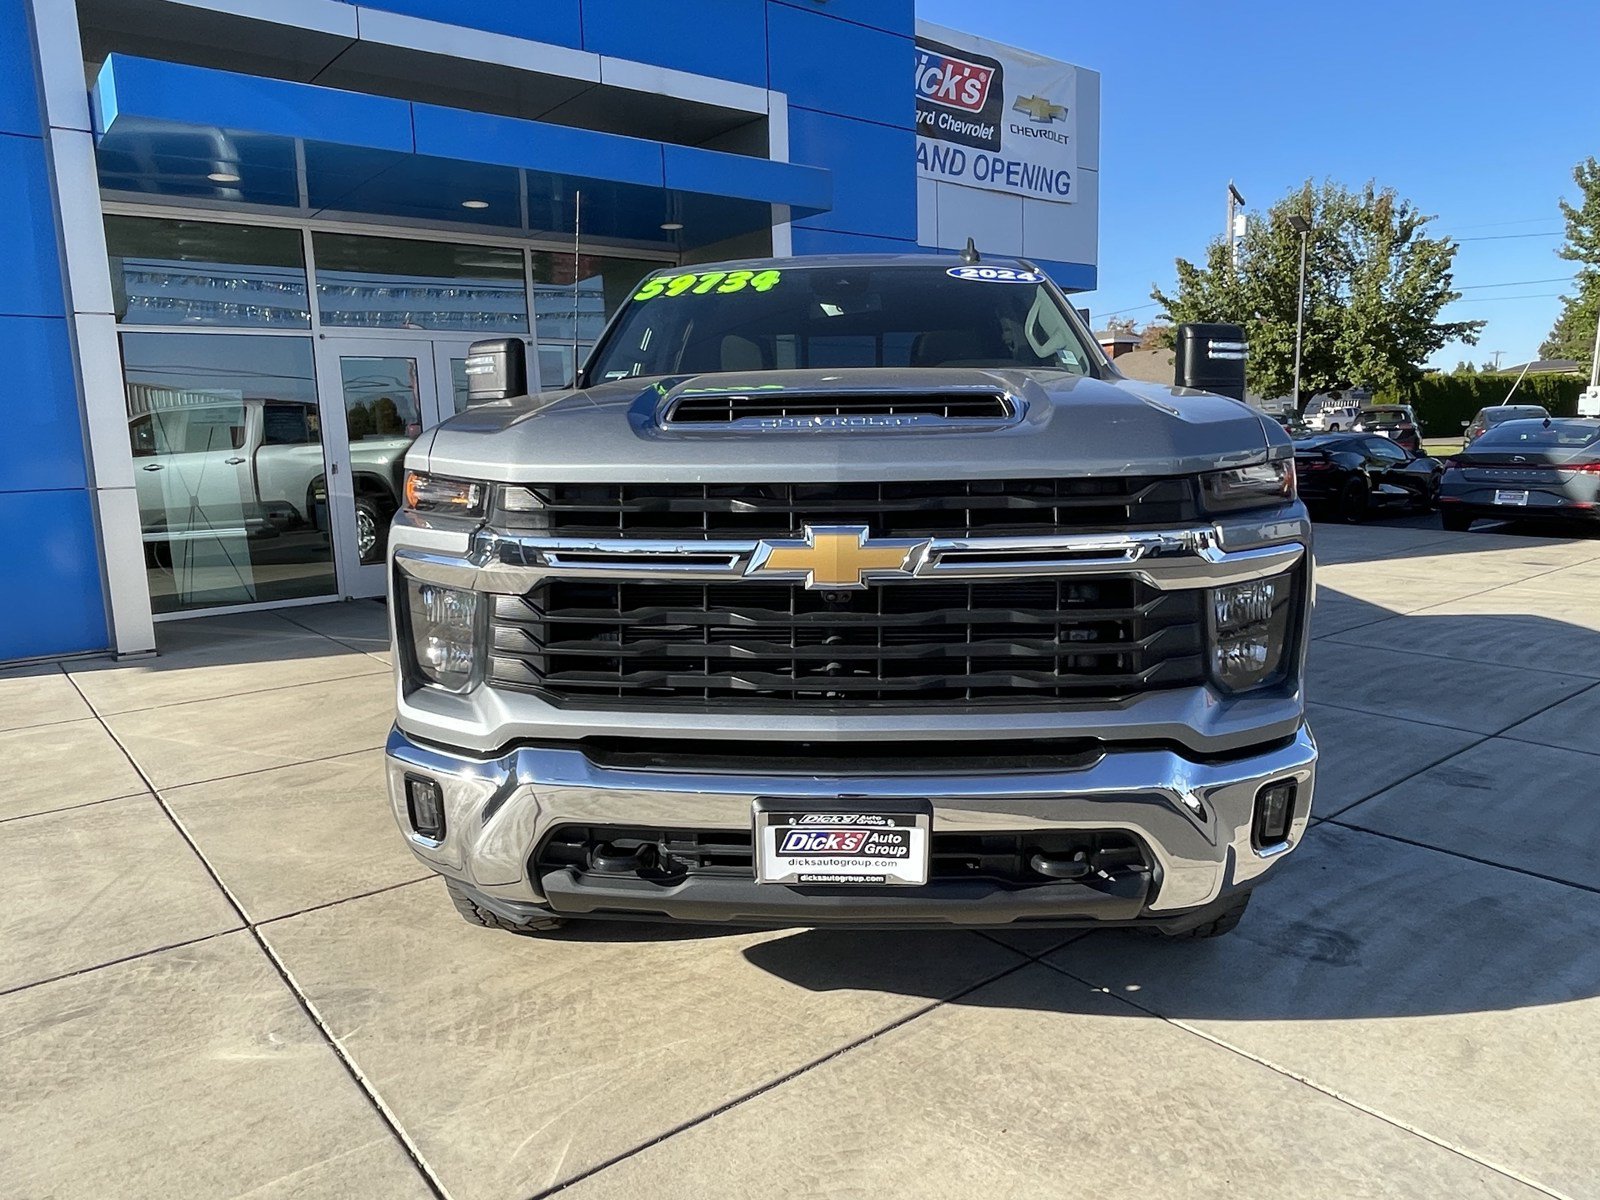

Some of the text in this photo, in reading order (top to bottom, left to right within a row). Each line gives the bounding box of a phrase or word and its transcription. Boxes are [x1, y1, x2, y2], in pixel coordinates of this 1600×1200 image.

[915, 54, 982, 105] ick's
[916, 110, 994, 140] ard Chevrolet
[1010, 124, 1069, 145] CHEVROLET
[917, 142, 1071, 196] AND OPENING
[959, 268, 1037, 282] 2024
[633, 270, 781, 301] 59734
[786, 833, 857, 850] Dick's
[868, 832, 902, 844] Auto
[865, 843, 907, 857] Group
[788, 858, 898, 868] dicksautogroup.com
[800, 873, 884, 884] dicksautogroup.com
